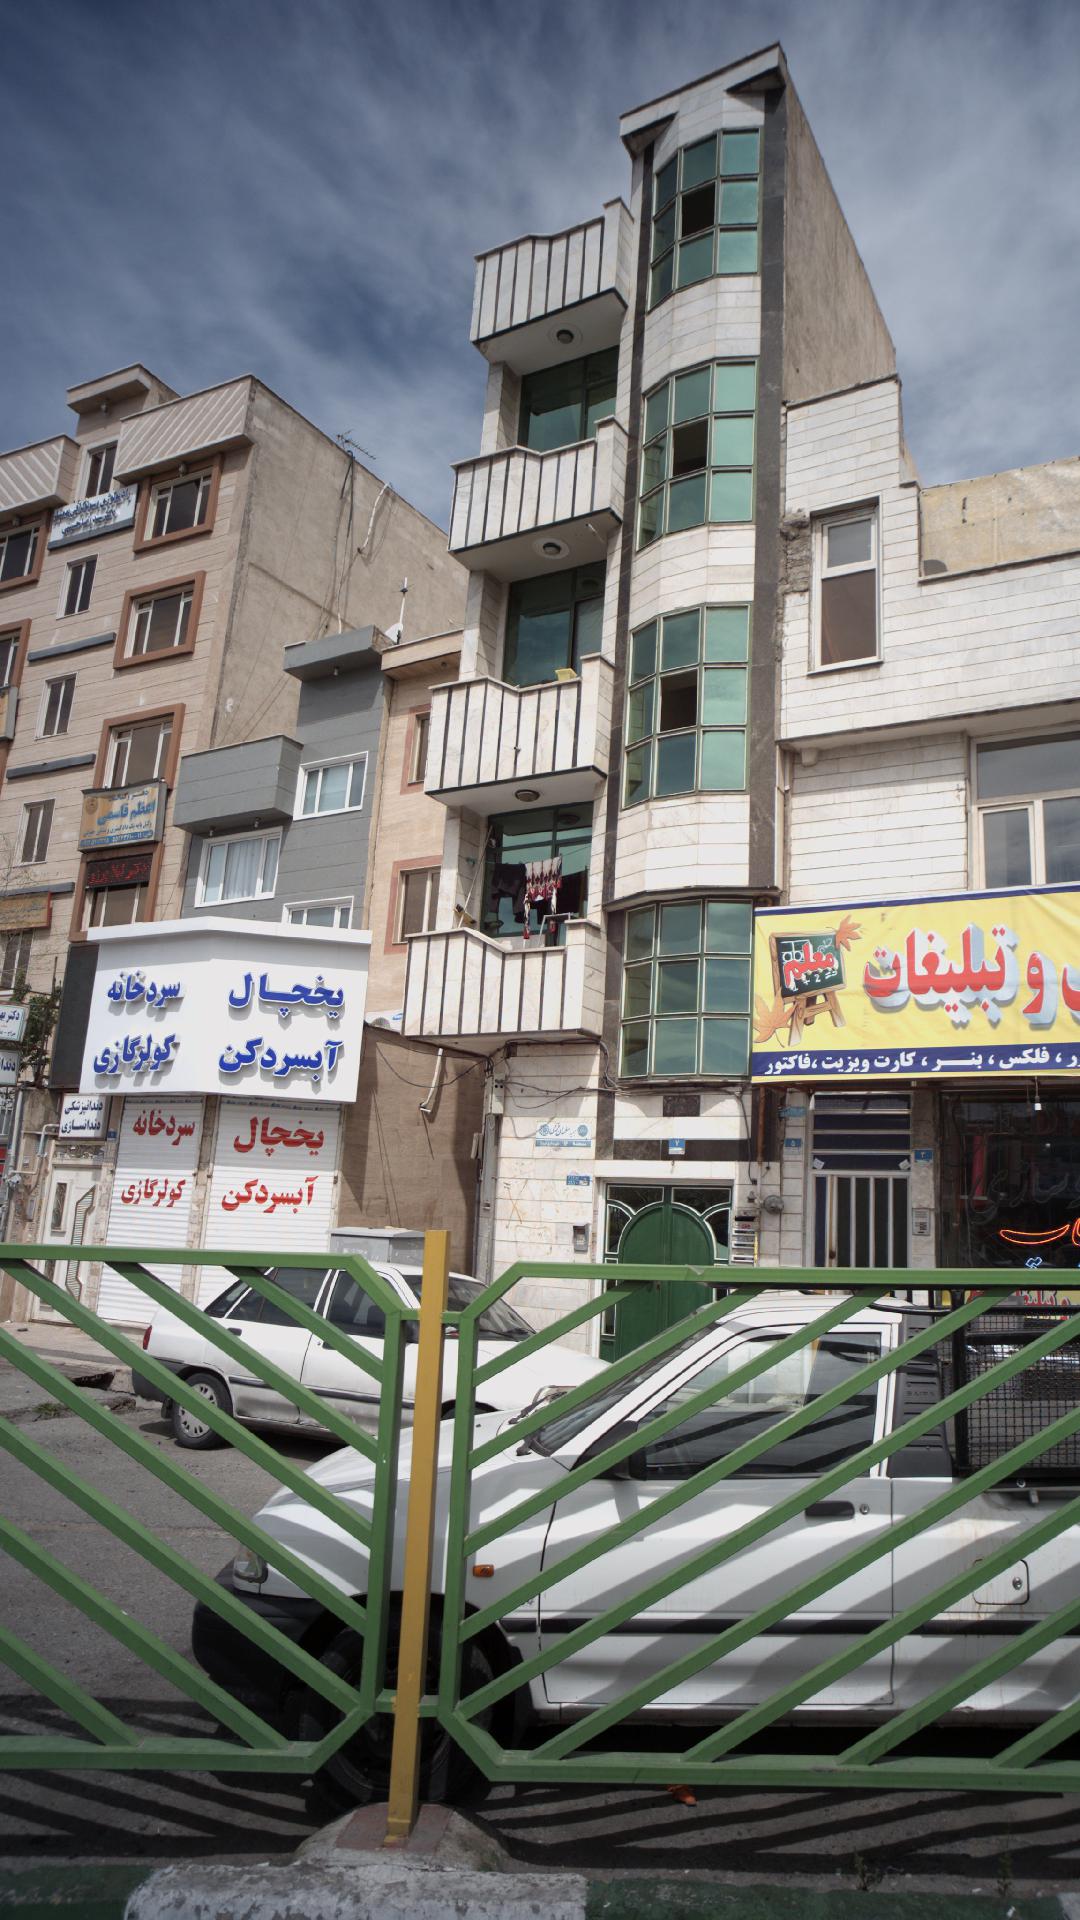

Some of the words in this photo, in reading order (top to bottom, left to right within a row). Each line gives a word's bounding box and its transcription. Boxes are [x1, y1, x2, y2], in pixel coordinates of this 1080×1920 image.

[863, 924, 1007, 1014] تبلیغات
[1022, 951, 1045, 1014] و
[107, 970, 181, 1008] سردخانه
[228, 971, 344, 1018] یخچال
[218, 1036, 344, 1082] آبسردکن
[821, 1055, 870, 1073] ویزیت
[873, 1051, 917, 1072] کارت
[931, 1052, 983, 1072] بنر
[999, 1046, 1050, 1069] فلکس
[64, 1100, 104, 1115] دندانپزشکی
[133, 1109, 195, 1146] سردخانه
[233, 1116, 325, 1157] یخچال
[221, 1175, 320, 1214] آبسردکن
